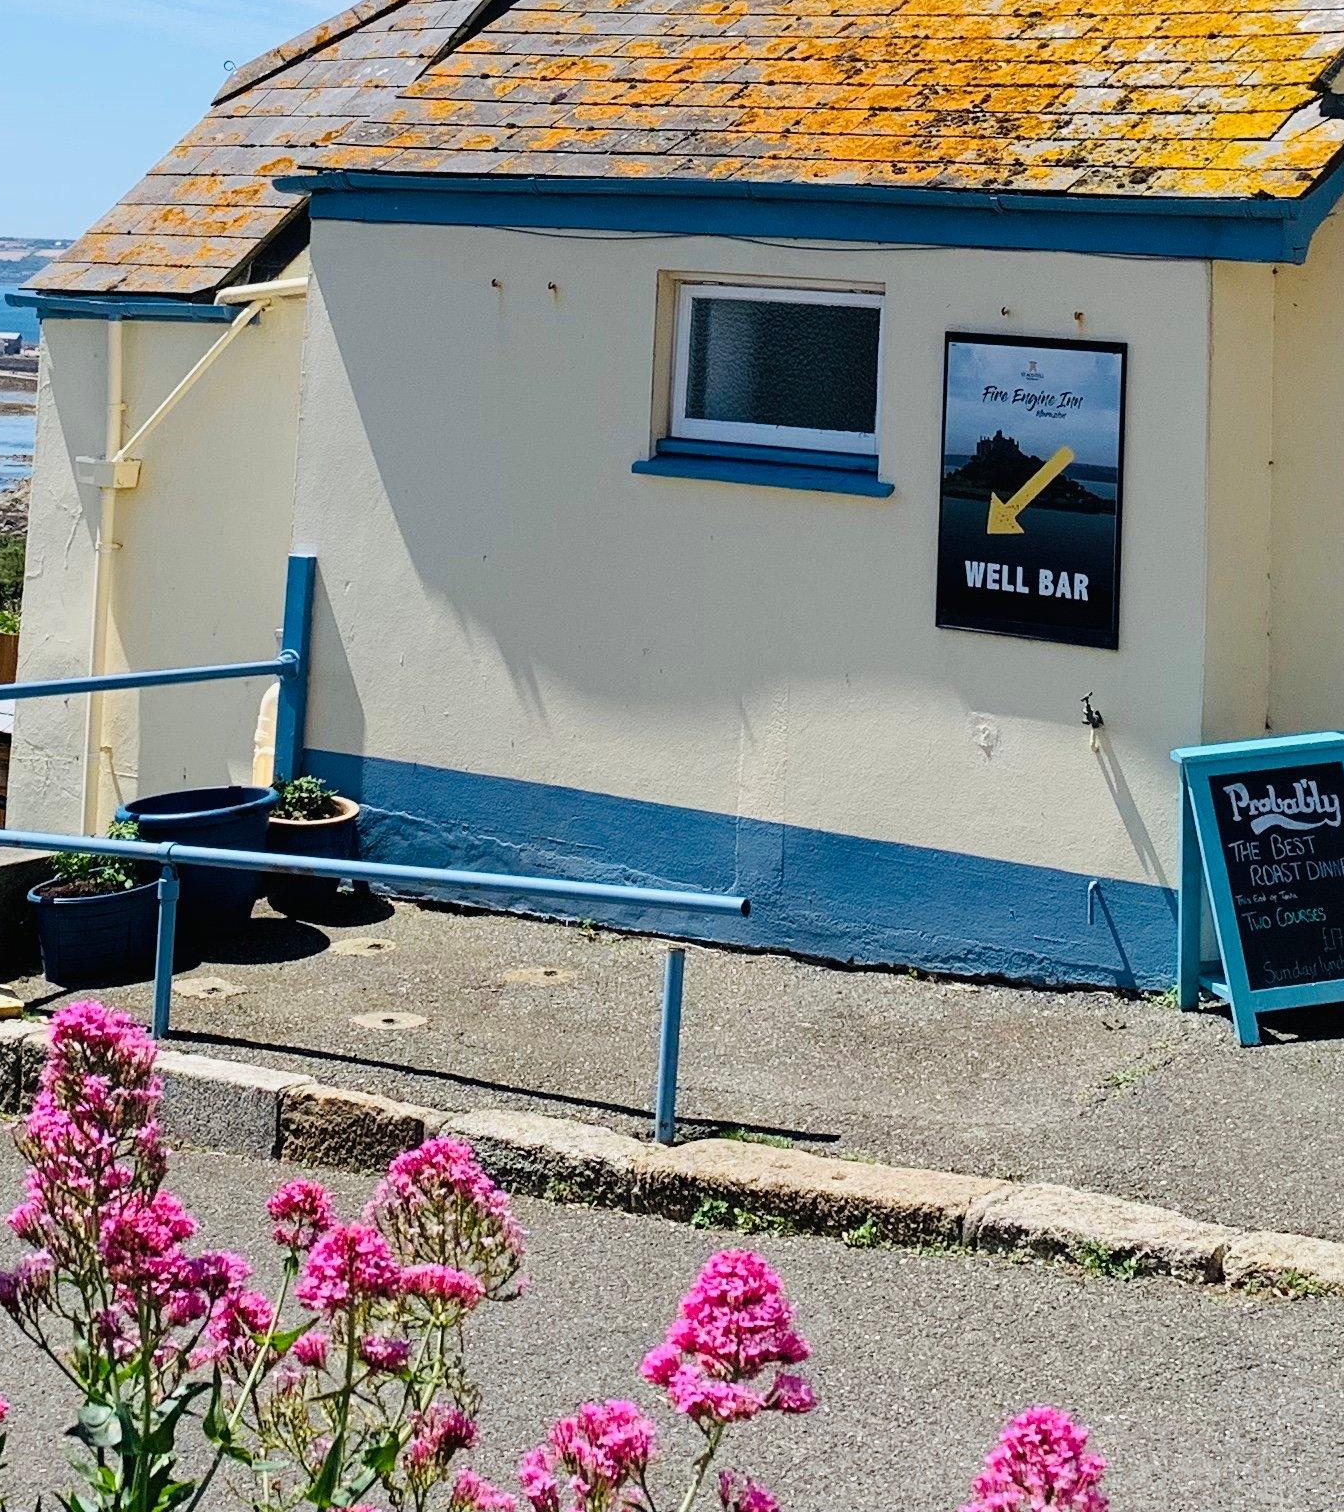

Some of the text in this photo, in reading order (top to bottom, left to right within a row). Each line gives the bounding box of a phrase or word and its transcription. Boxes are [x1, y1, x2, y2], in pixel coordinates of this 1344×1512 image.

[982, 385, 1084, 411] Fire Engine Inn
[964, 560, 1089, 602] WELL BAR
[1223, 778, 1341, 829] Probably
[1228, 834, 1316, 862] THE BEST
[1250, 861, 1302, 887] ROAST
[1263, 960, 1317, 985] Sunday
